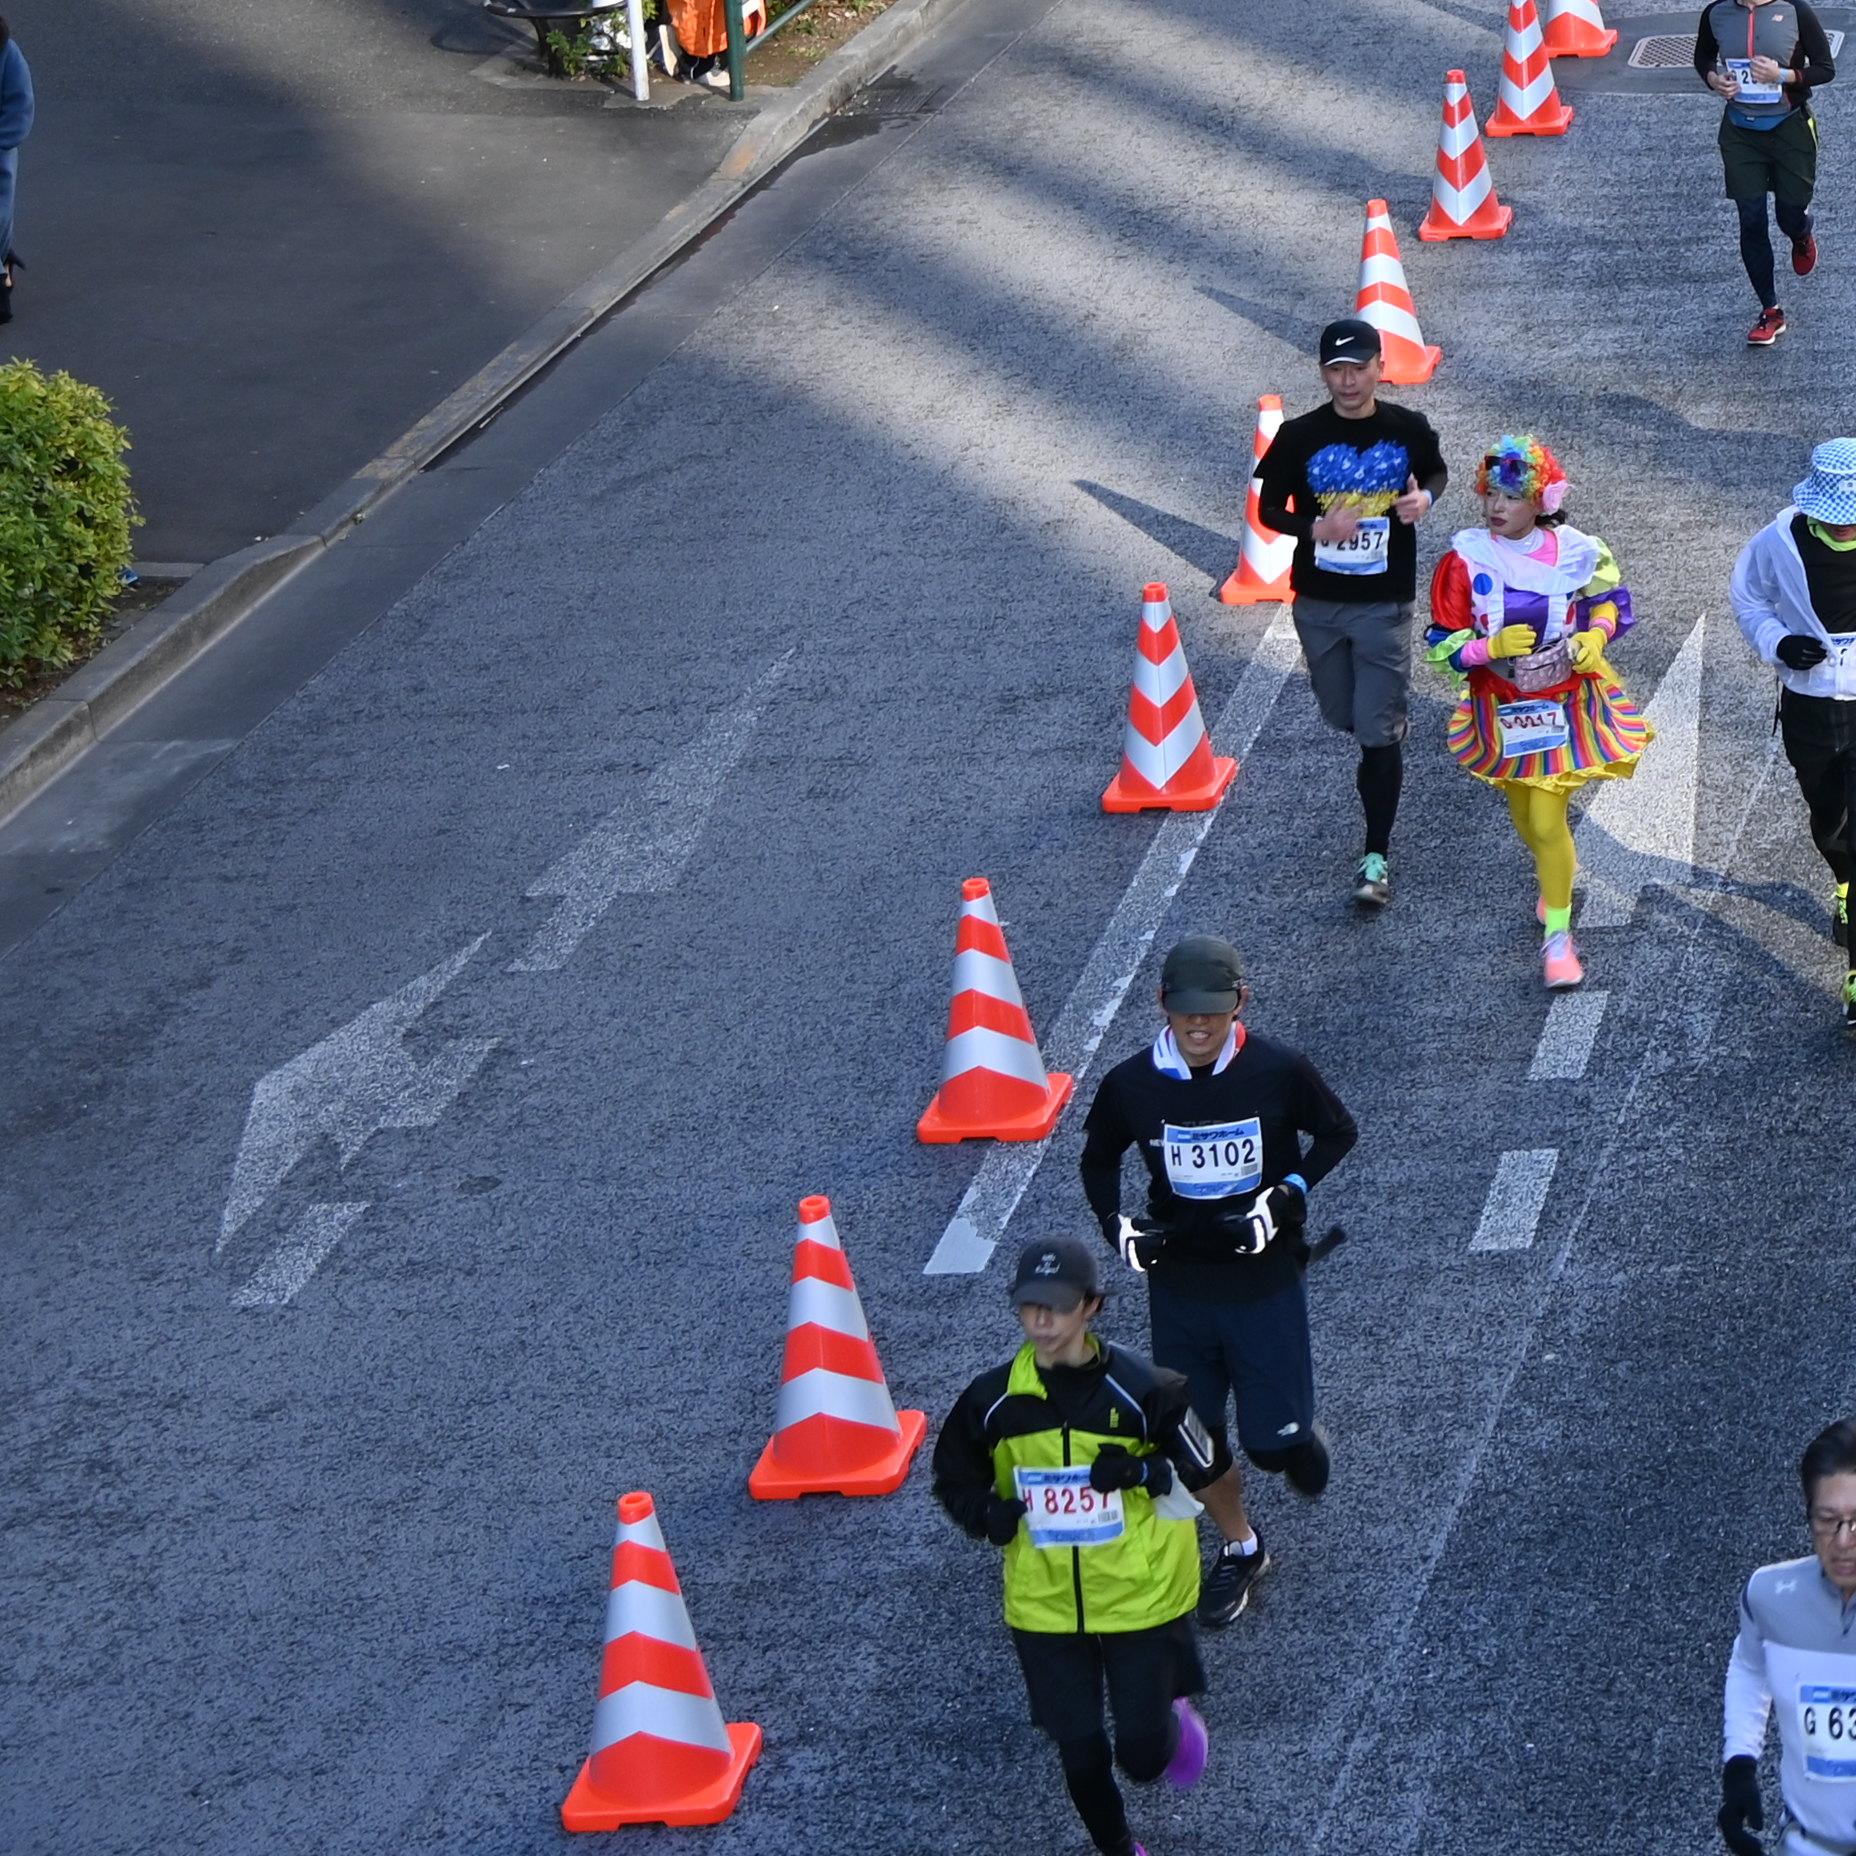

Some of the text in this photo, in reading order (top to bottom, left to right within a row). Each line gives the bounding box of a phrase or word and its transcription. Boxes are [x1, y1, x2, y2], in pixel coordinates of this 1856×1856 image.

[1337, 531, 1384, 552] 2957
[1172, 1138, 1257, 1169] H 3102
[1022, 1486, 1110, 1515] H 8257
[1804, 1706, 1816, 1736] G
